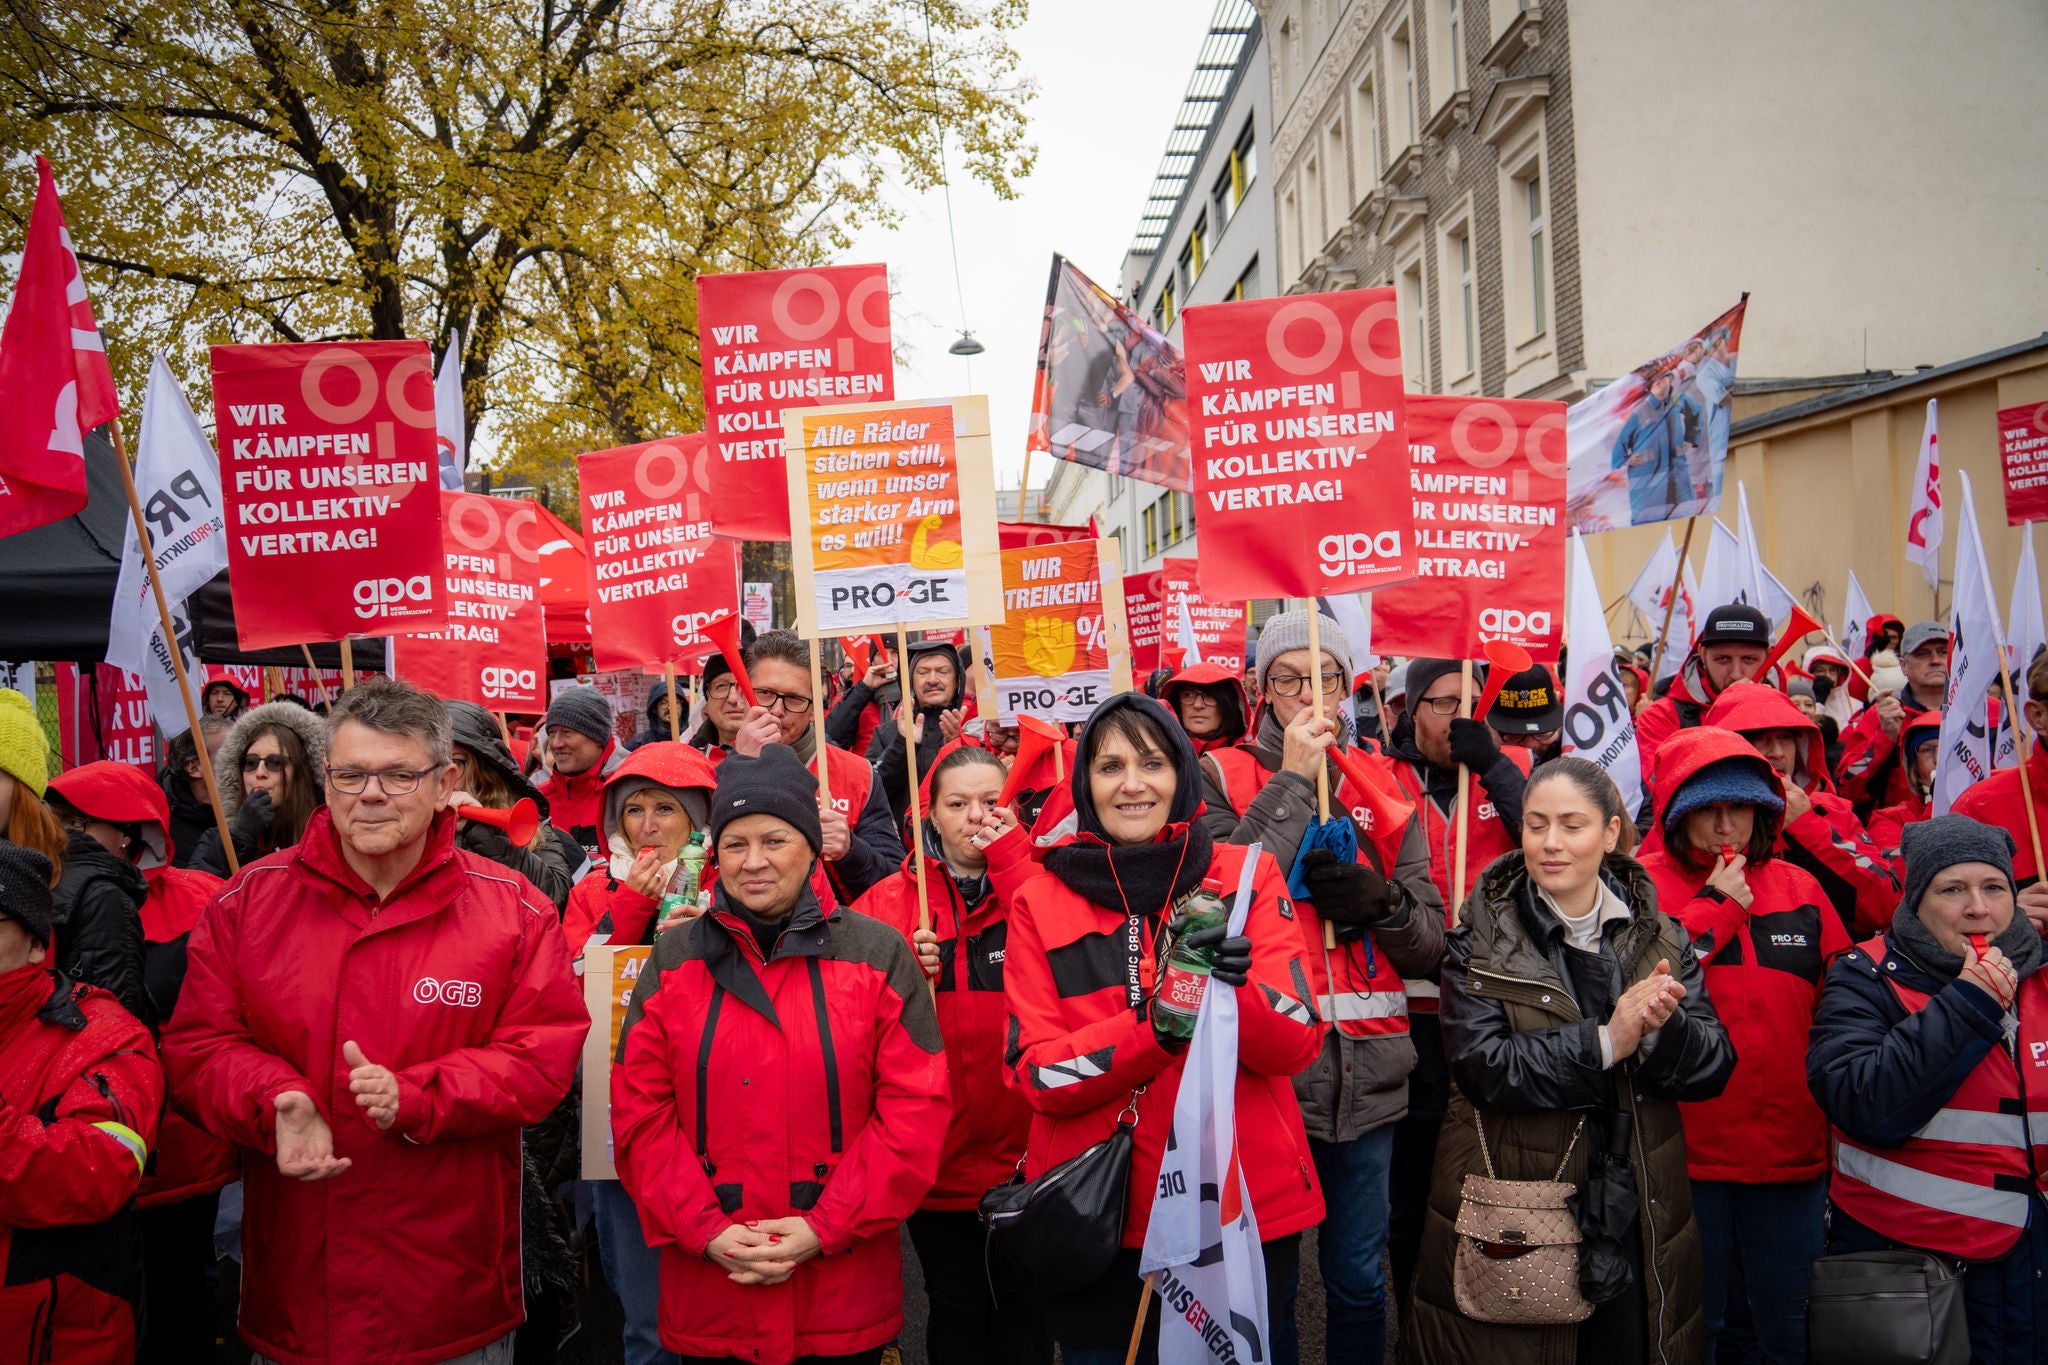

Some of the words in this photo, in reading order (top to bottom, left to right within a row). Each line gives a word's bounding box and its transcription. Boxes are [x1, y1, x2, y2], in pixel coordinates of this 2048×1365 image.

[712, 324, 759, 346] WIR
[714, 348, 831, 376] KÄMPFEN
[1199, 359, 1252, 384] WIR
[716, 380, 763, 404] FÜR
[770, 374, 884, 400] UNSEREN
[1202, 383, 1335, 416] KÄMPFEN
[229, 404, 287, 427] WIR
[1204, 420, 1258, 448] FÜR
[1265, 410, 1394, 442] UNSEREN
[232, 433, 370, 460] KÄMPFEN
[811, 426, 856, 448] Alle
[862, 420, 930, 444] Räder
[2004, 428, 2028, 440] WIR
[2006, 437, 2048, 452] KÄMPF
[814, 450, 890, 474] stehen
[896, 444, 946, 468] still,
[1207, 446, 1368, 480] KOLLEKTIV-
[1408, 444, 1436, 464] IR
[2006, 452, 2031, 465] FÜR
[236, 466, 293, 493] FÜR
[300, 462, 427, 489] UNSEREN
[817, 478, 878, 500] wenn
[886, 472, 950, 494] unser
[1410, 469, 1506, 495] ÄMPFEN
[590, 490, 626, 510] WIR
[1209, 479, 1343, 512] VERTRAG!
[238, 496, 400, 525] KOLLEKTIV-
[592, 502, 682, 534] KÄMPFEN
[818, 501, 902, 526] starker
[906, 496, 954, 518] Arm
[1443, 502, 1556, 526] UNSEREN
[240, 528, 378, 557] VERTRAG!
[594, 535, 631, 557] FÜR
[634, 521, 712, 548] UNSERE
[820, 533, 847, 552] es
[854, 523, 903, 548] will!
[446, 554, 495, 574] PFEN
[596, 548, 704, 580] KOLLEKTIV-
[1318, 530, 1402, 577] gpa
[1022, 556, 1062, 580] WIR
[1418, 558, 1505, 579] RTRAG!
[353, 575, 432, 619] gpa
[446, 578, 534, 600] UNSEREN
[598, 573, 688, 604] VERTRAG!
[1004, 580, 1098, 610] TREIKEN!
[1126, 594, 1146, 604] WIR
[1168, 580, 1189, 590] WIR
[1130, 614, 1150, 626] FÜR
[1191, 607, 1242, 618] UNSEREN
[481, 667, 536, 698] gpa
[413, 977, 482, 1008] ÖGB
